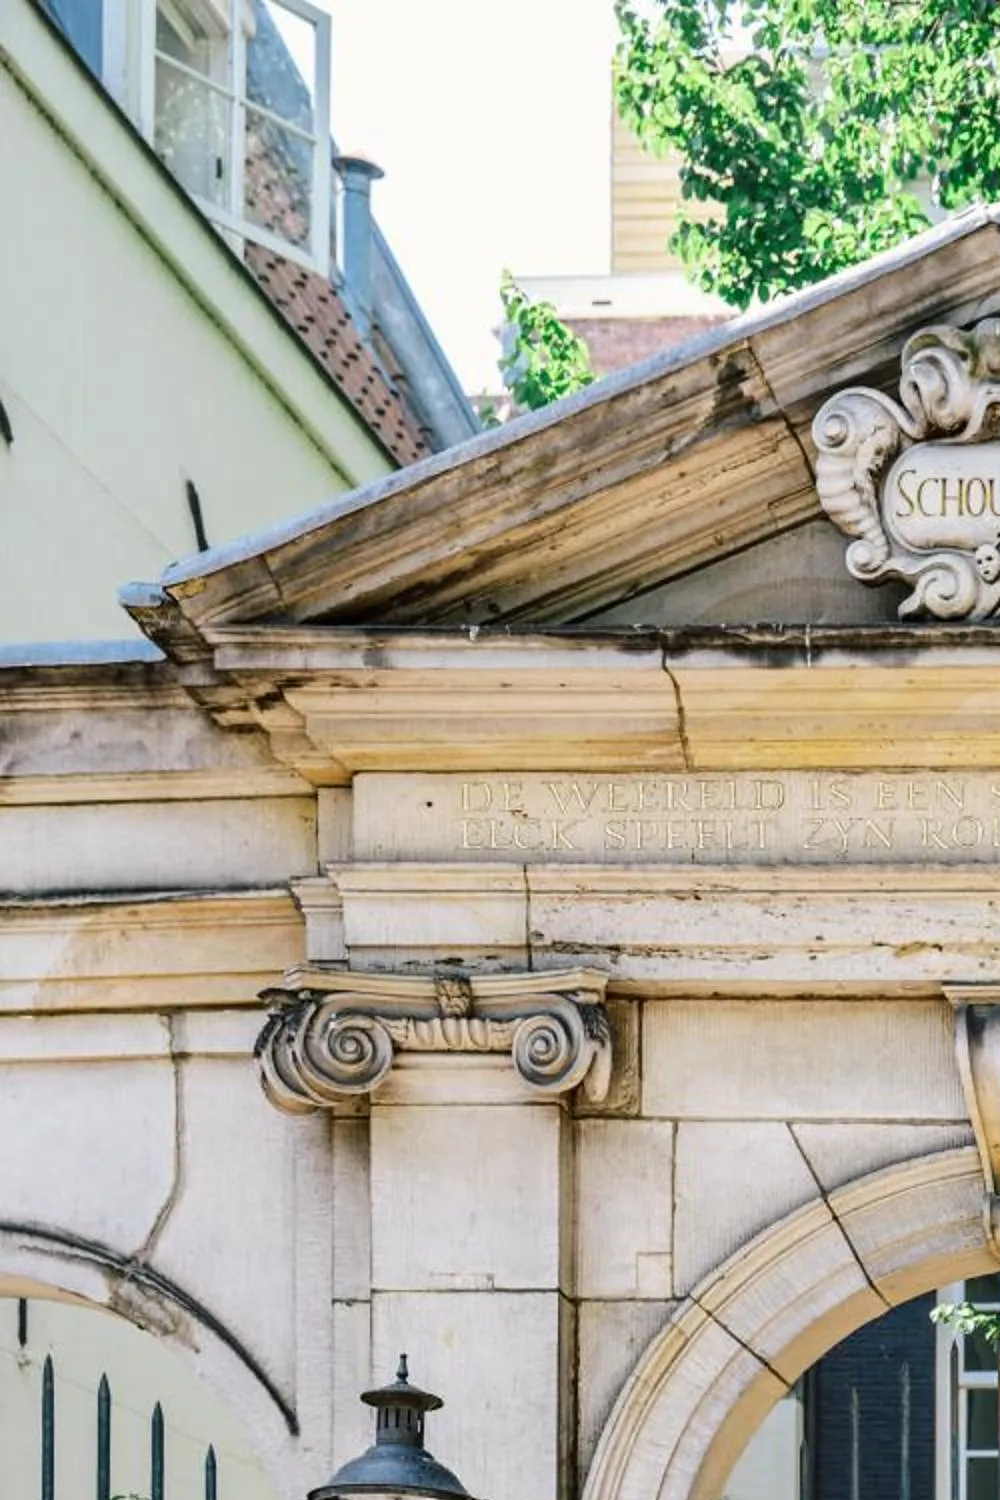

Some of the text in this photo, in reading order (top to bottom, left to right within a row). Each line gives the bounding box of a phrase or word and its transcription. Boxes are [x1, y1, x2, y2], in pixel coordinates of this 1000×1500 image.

[460, 780, 525, 813] DE
[807, 778, 854, 812] IS
[872, 777, 968, 812] EEN
[458, 817, 584, 850] ELCK
[800, 816, 897, 850] ZYN
